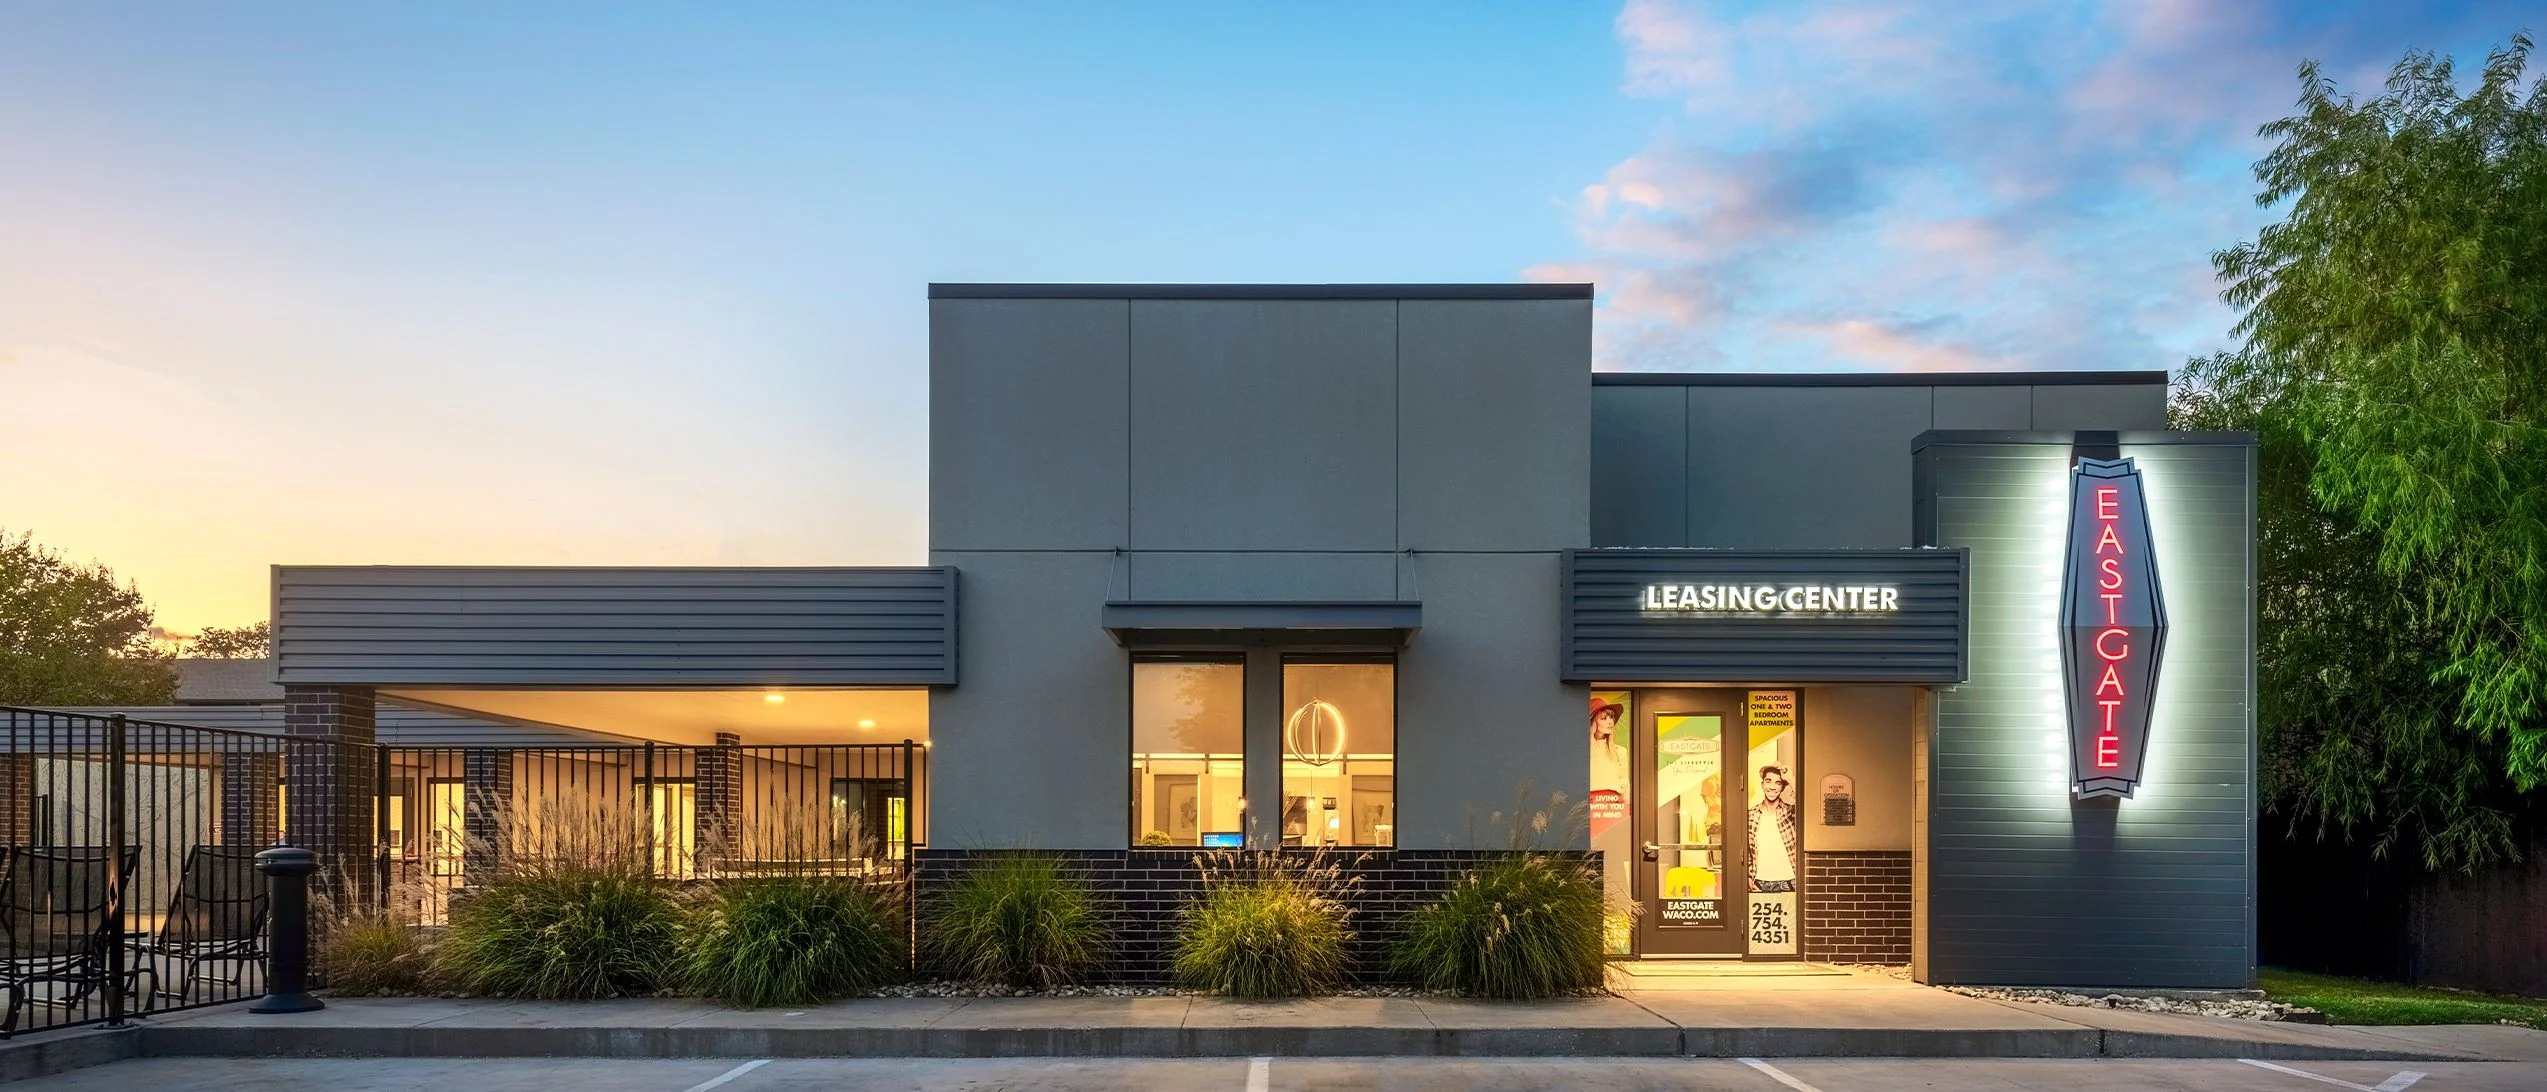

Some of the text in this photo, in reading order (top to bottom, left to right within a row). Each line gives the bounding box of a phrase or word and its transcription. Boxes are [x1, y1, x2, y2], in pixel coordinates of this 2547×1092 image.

[1647, 585, 1899, 611] LEASING CENTER
[2095, 488, 2129, 768] EASTGATE
[1670, 742, 1711, 751] EASTGATE
[1667, 901, 1714, 910] EASTGATE
[1751, 902, 1788, 916] 254.
[1662, 910, 1719, 919] WACO.COM
[1751, 916, 1788, 930] 754.
[1751, 930, 1789, 944] 4351
